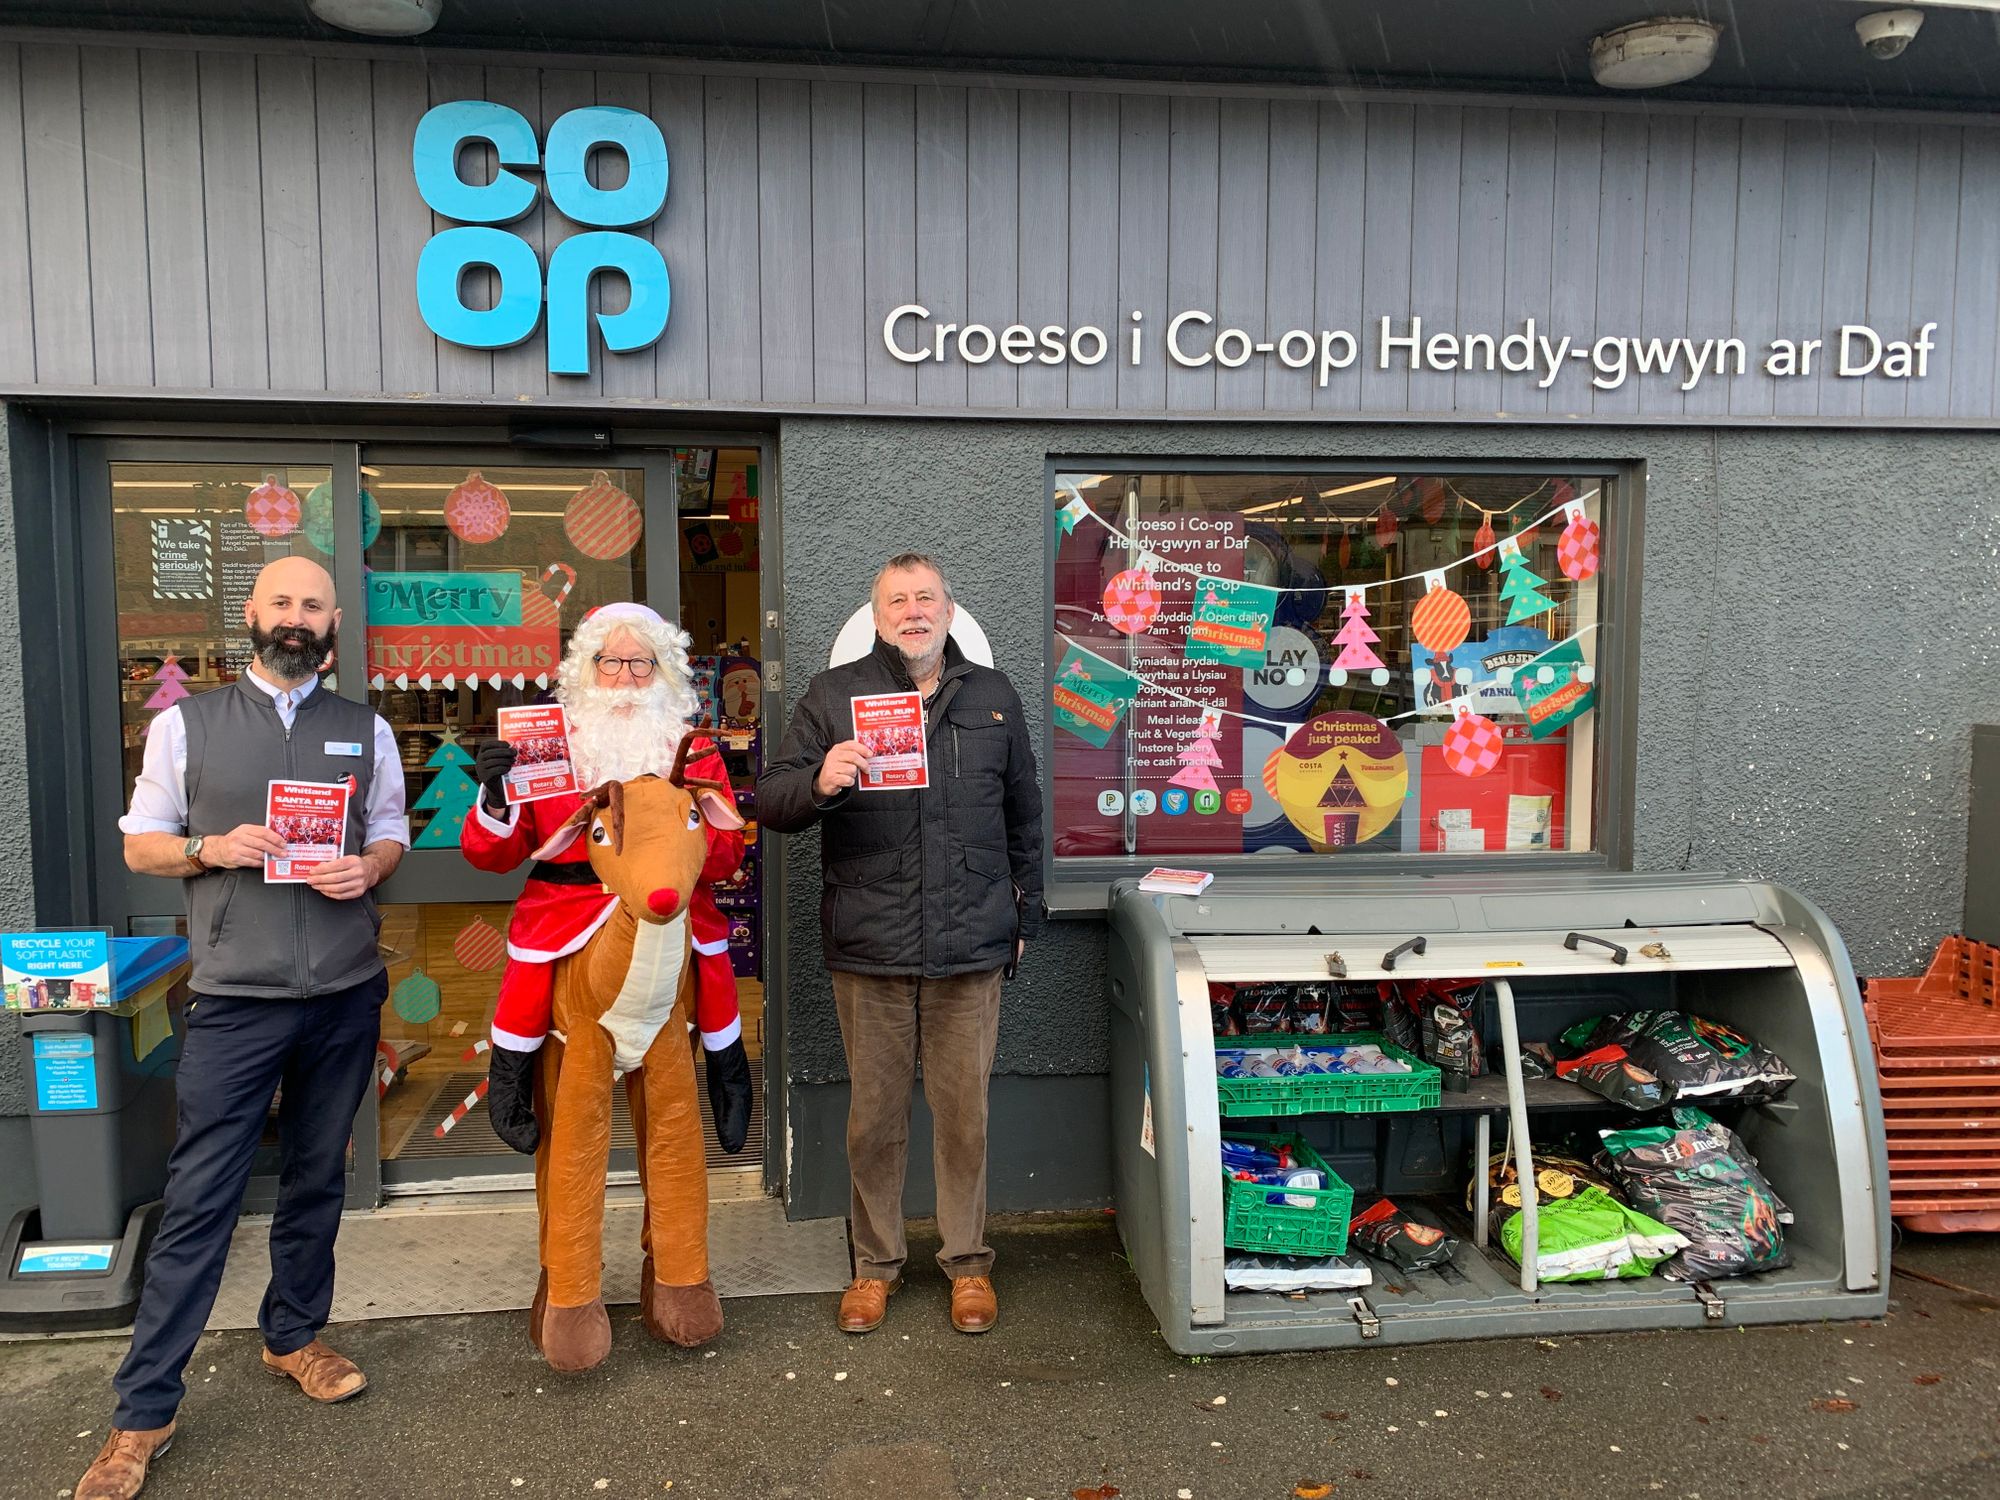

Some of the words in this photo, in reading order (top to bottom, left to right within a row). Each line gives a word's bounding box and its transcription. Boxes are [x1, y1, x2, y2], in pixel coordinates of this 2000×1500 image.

[883, 304, 1108, 365] Croeso
[1131, 310, 1142, 365] i
[1166, 310, 1358, 387] Co-op
[1378, 316, 1747, 391] Hendy-gwyn
[1766, 337, 1822, 377] ar
[1839, 322, 1938, 378] Daf
[1125, 518, 1177, 531] Croeso
[1180, 518, 1185, 531] i
[1188, 518, 1234, 535] Co-op
[158, 540, 176, 549] We
[178, 540, 201, 549] take
[1108, 535, 1201, 553] Hendy-gwyn
[1205, 538, 1221, 549] ar
[1223, 535, 1250, 550] Daf
[159, 551, 188, 560] crime
[159, 561, 204, 572] seriously
[1143, 560, 1203, 573] elcome
[1206, 561, 1222, 573] to
[1195, 578, 1241, 595] Co-op
[375, 580, 513, 621] Merry
[1149, 612, 1196, 626] ddyddiol
[1206, 612, 1242, 625] Open
[1242, 611, 1265, 625] daily
[1147, 626, 1169, 636] 7am
[1179, 625, 1209, 639] 10pm
[371, 635, 553, 668] hristmas
[1132, 656, 1179, 669] Syniadau
[1182, 656, 1219, 668] prydau
[1266, 650, 1308, 666] LAY
[1183, 672, 1190, 680] a
[1191, 670, 1227, 682] Llysiau
[1253, 668, 1307, 685] NO
[1185, 687, 1192, 697] y
[1194, 684, 1216, 697] siop
[1479, 687, 1516, 697] WANN
[864, 698, 908, 708] Whitland
[1128, 698, 1168, 708] Peiriant
[509, 710, 550, 719] Whitland
[858, 709, 892, 719] SANTA
[894, 707, 916, 715] RUN
[503, 721, 535, 730] SANTA
[536, 719, 559, 728] RUN
[1147, 715, 1175, 725] Meal
[1176, 715, 1204, 725] ideas
[1312, 721, 1377, 732] Christmas
[1128, 729, 1152, 739] Fruit
[1153, 729, 1163, 739] &
[1165, 729, 1223, 741] Vegetables
[1307, 733, 1331, 746] just
[1334, 733, 1381, 746] peaked
[1138, 743, 1174, 753] Instore
[1176, 743, 1212, 754] bakery
[1127, 757, 1150, 767] Free
[1152, 757, 1176, 766] cash
[1179, 757, 1223, 766] machine
[532, 781, 553, 789] Rotary
[283, 786, 332, 796] Whitland
[274, 795, 313, 805] SANTA
[314, 798, 339, 806] RUN
[1333, 822, 1341, 846] OSTA
[715, 897, 735, 906] today
[11, 939, 61, 949] RECYCLE
[64, 938, 96, 948] YOUR
[15, 950, 45, 960] SOFT
[47, 949, 93, 959] PLASTIC
[26, 962, 56, 970] RIGHT
[58, 961, 83, 969] HERE
[1455, 993, 1474, 1004] fire
